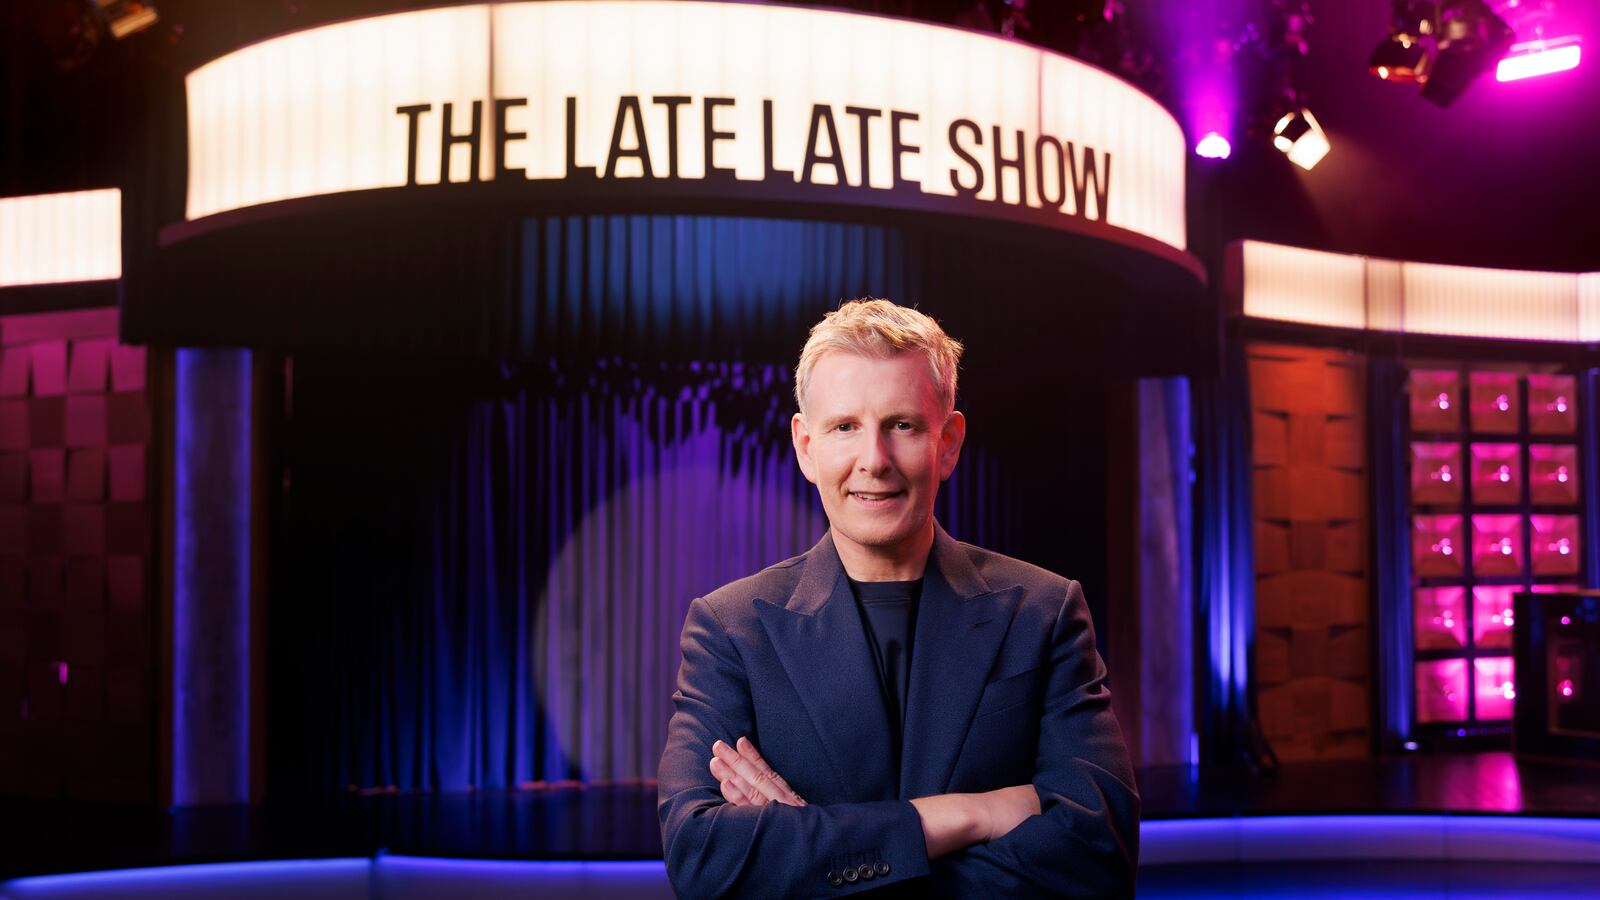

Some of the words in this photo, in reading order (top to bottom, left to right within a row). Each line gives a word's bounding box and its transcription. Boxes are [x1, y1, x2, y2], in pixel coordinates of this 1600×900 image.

[396, 97, 528, 185] THE
[566, 95, 736, 180] LATE
[763, 99, 921, 190] LATE
[948, 118, 1112, 222] SHOW
